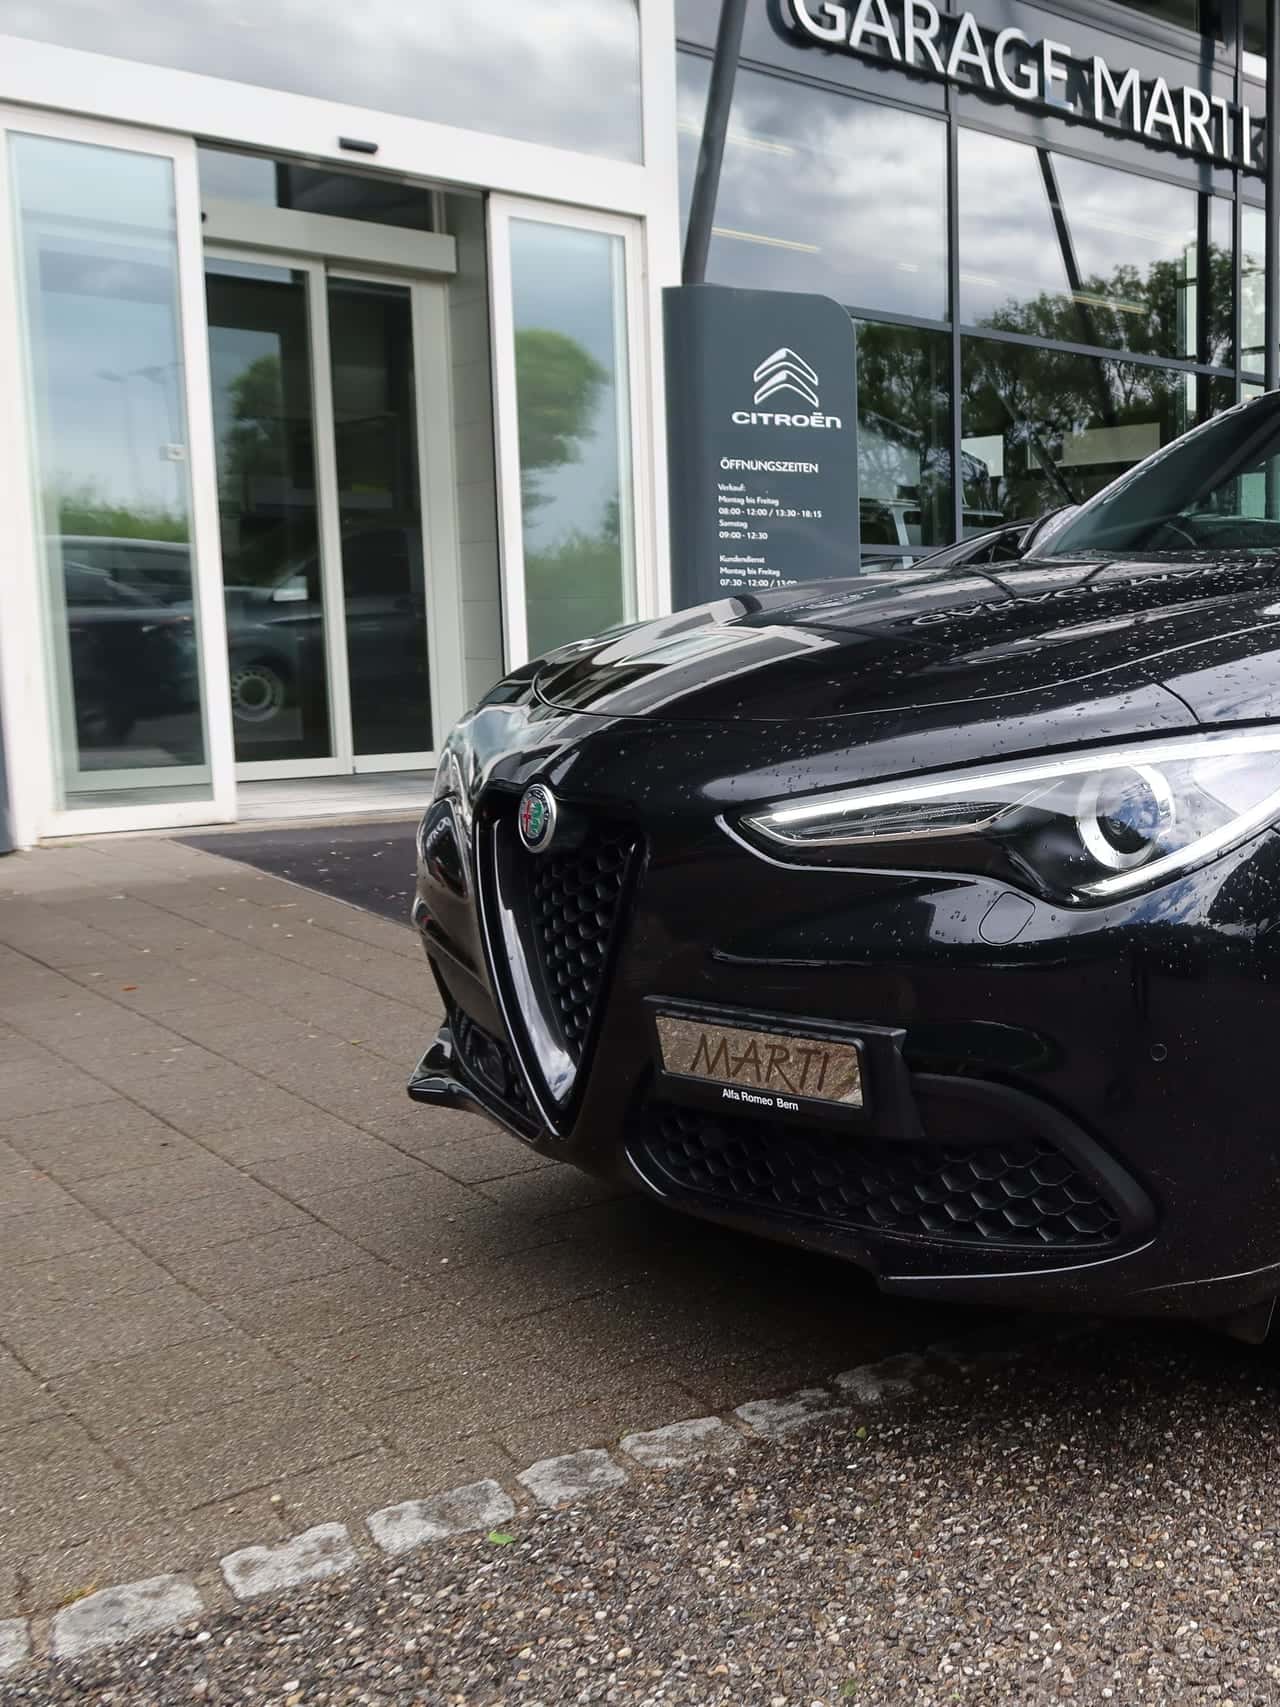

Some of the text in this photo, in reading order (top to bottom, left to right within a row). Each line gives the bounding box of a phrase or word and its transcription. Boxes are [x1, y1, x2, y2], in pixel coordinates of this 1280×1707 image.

[793, 0, 1075, 112] GARAGE
[1093, 55, 1251, 167] MARTI
[720, 457, 819, 473] ÖFFNUNGSZEITEN
[718, 496, 780, 507] Montag bis Freitag
[746, 508, 768, 516] 12:00
[719, 519, 748, 529] Samstag
[719, 567, 781, 577] Montag bis Freitag
[747, 579, 769, 587] 12:00
[690, 1033, 829, 1093] MARTI
[722, 1087, 799, 1111] Alfa Romeo Bern
